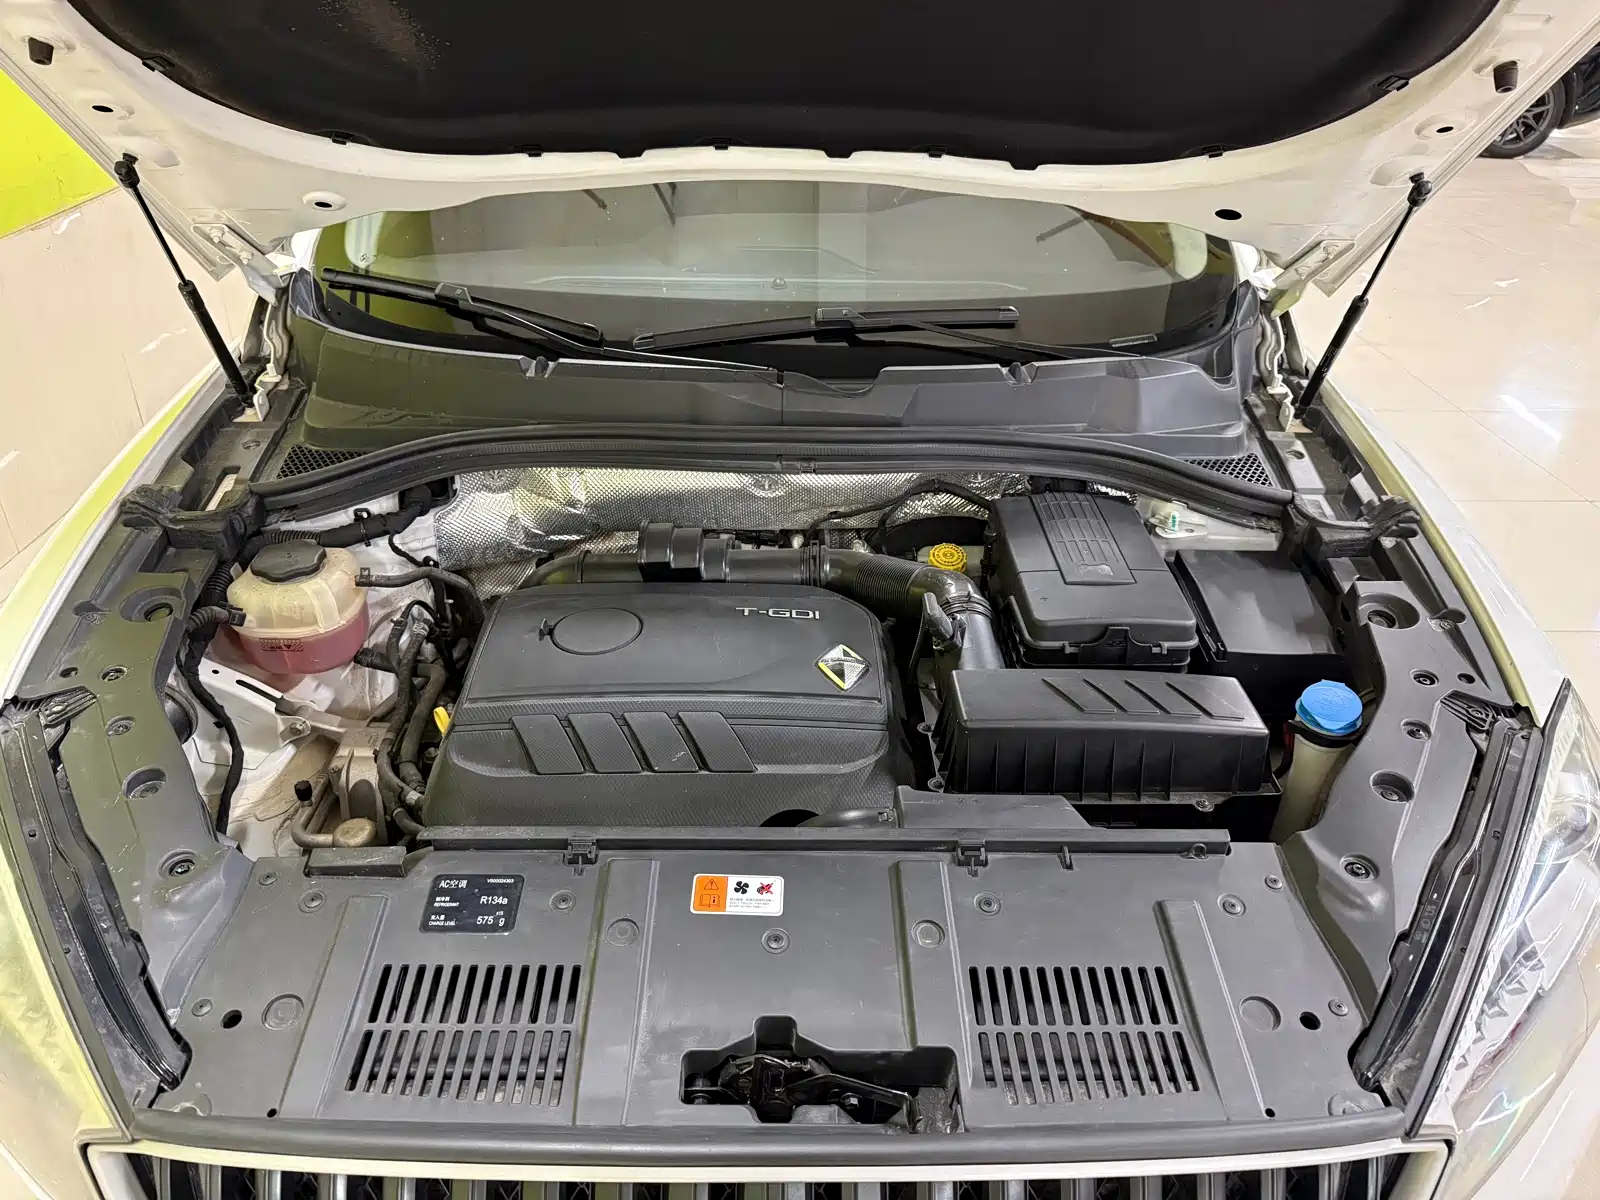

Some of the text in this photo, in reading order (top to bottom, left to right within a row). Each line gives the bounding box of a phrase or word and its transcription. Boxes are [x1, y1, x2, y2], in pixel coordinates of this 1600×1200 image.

[735, 607, 820, 619] T-GDI
[480, 895, 508, 904] R134a
[476, 915, 505, 926] 575 g
